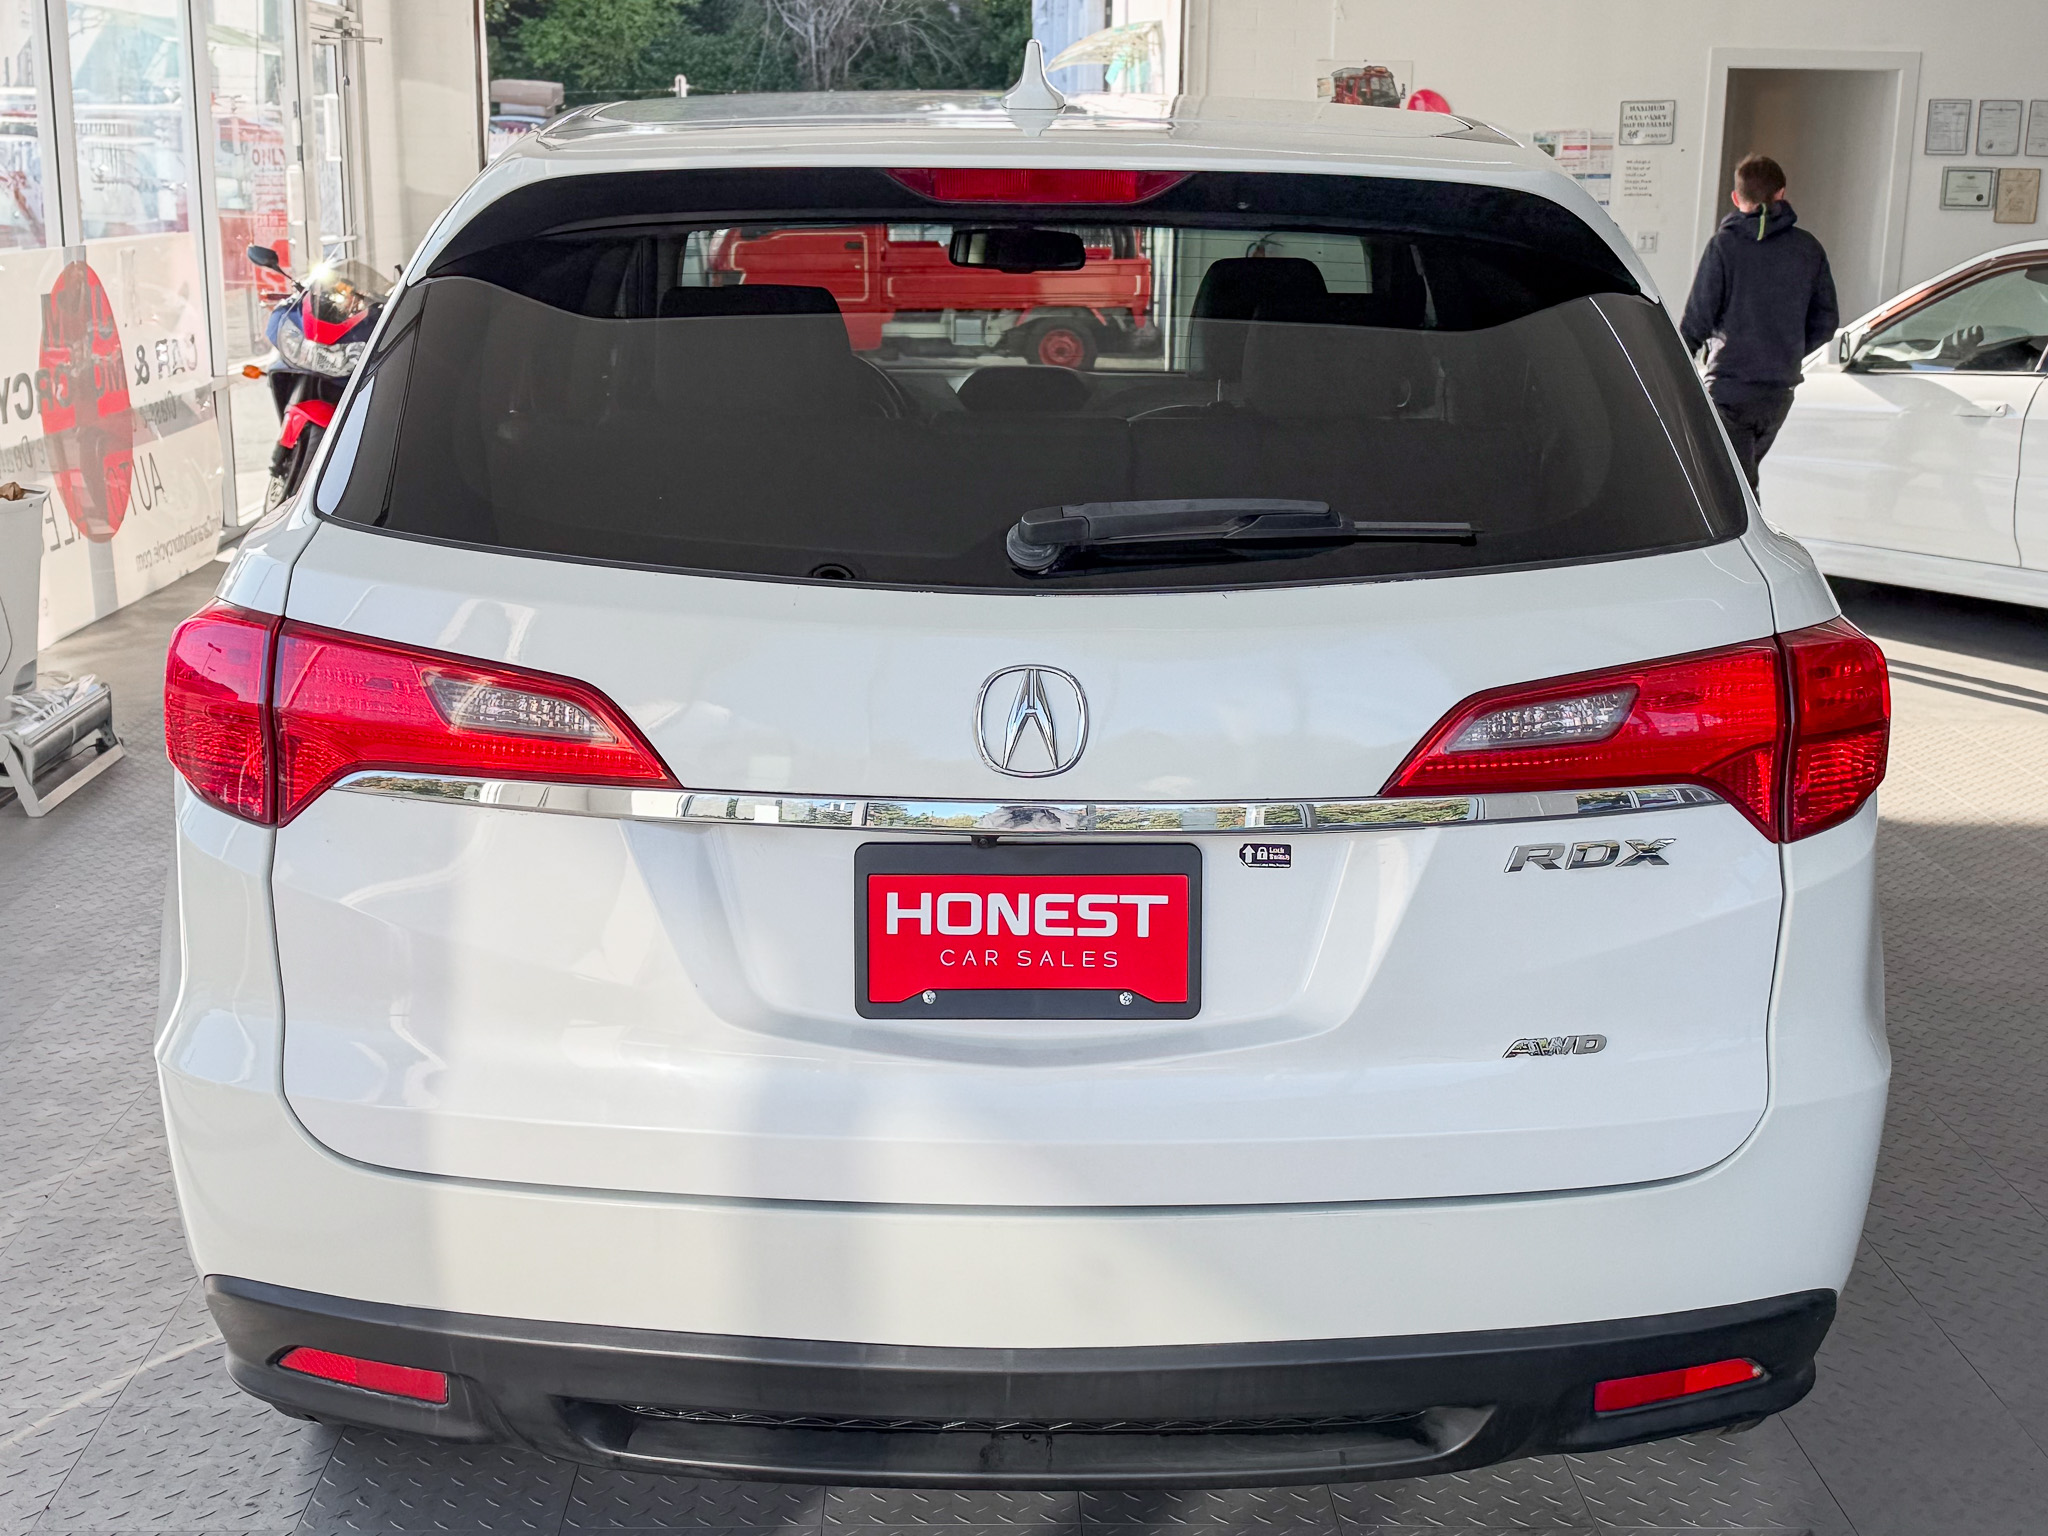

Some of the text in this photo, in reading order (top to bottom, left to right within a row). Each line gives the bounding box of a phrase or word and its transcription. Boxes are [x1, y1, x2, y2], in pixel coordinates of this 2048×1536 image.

[1504, 837, 1677, 873] RDX
[886, 892, 1169, 938] HONEST
[940, 949, 1119, 968] CAR SALES
[1502, 1033, 1608, 1058] AWD
